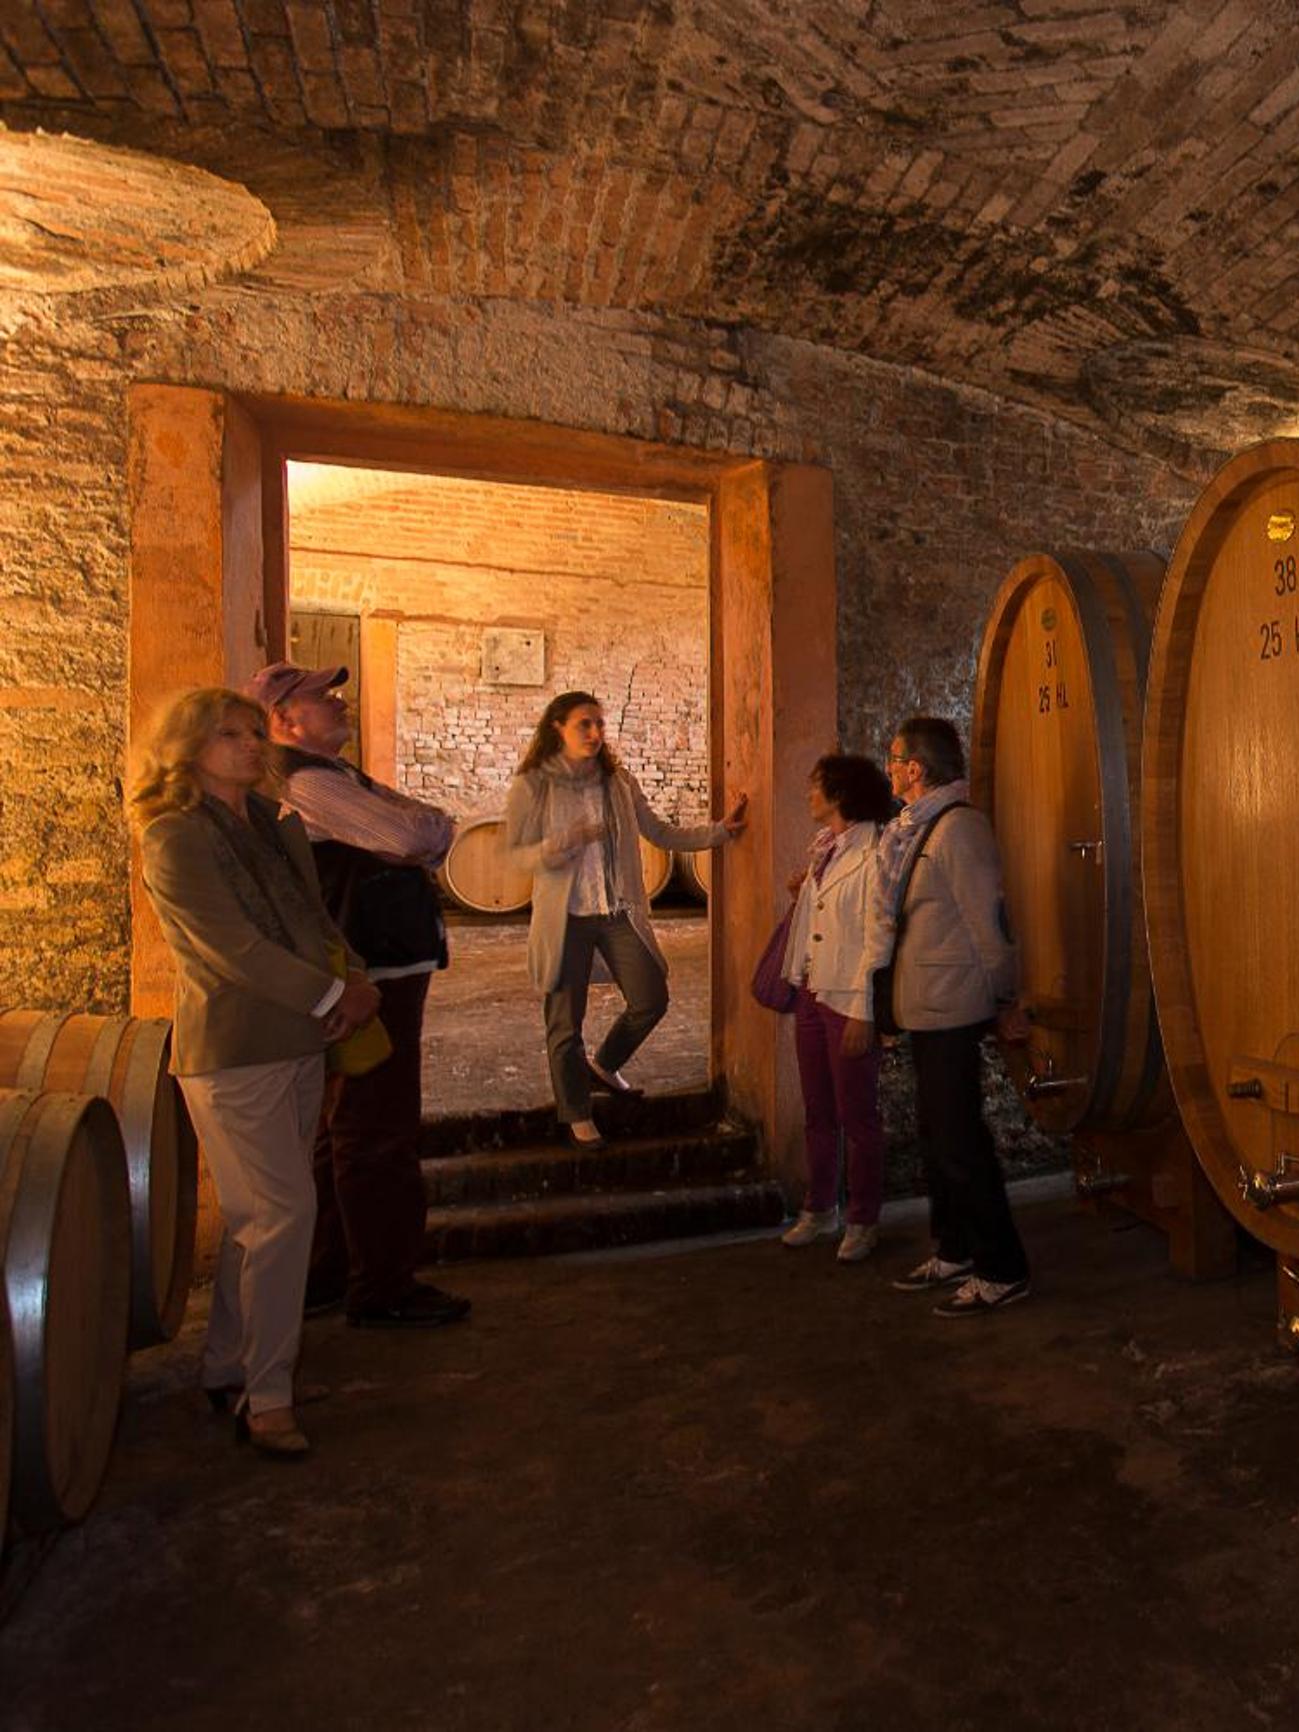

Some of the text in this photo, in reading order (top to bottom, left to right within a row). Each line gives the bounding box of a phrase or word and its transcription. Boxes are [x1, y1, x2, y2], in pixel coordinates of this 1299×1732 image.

[1274, 555, 1297, 597] 38
[1260, 621, 1282, 660] 25
[1039, 682, 1069, 712] 25 HL
